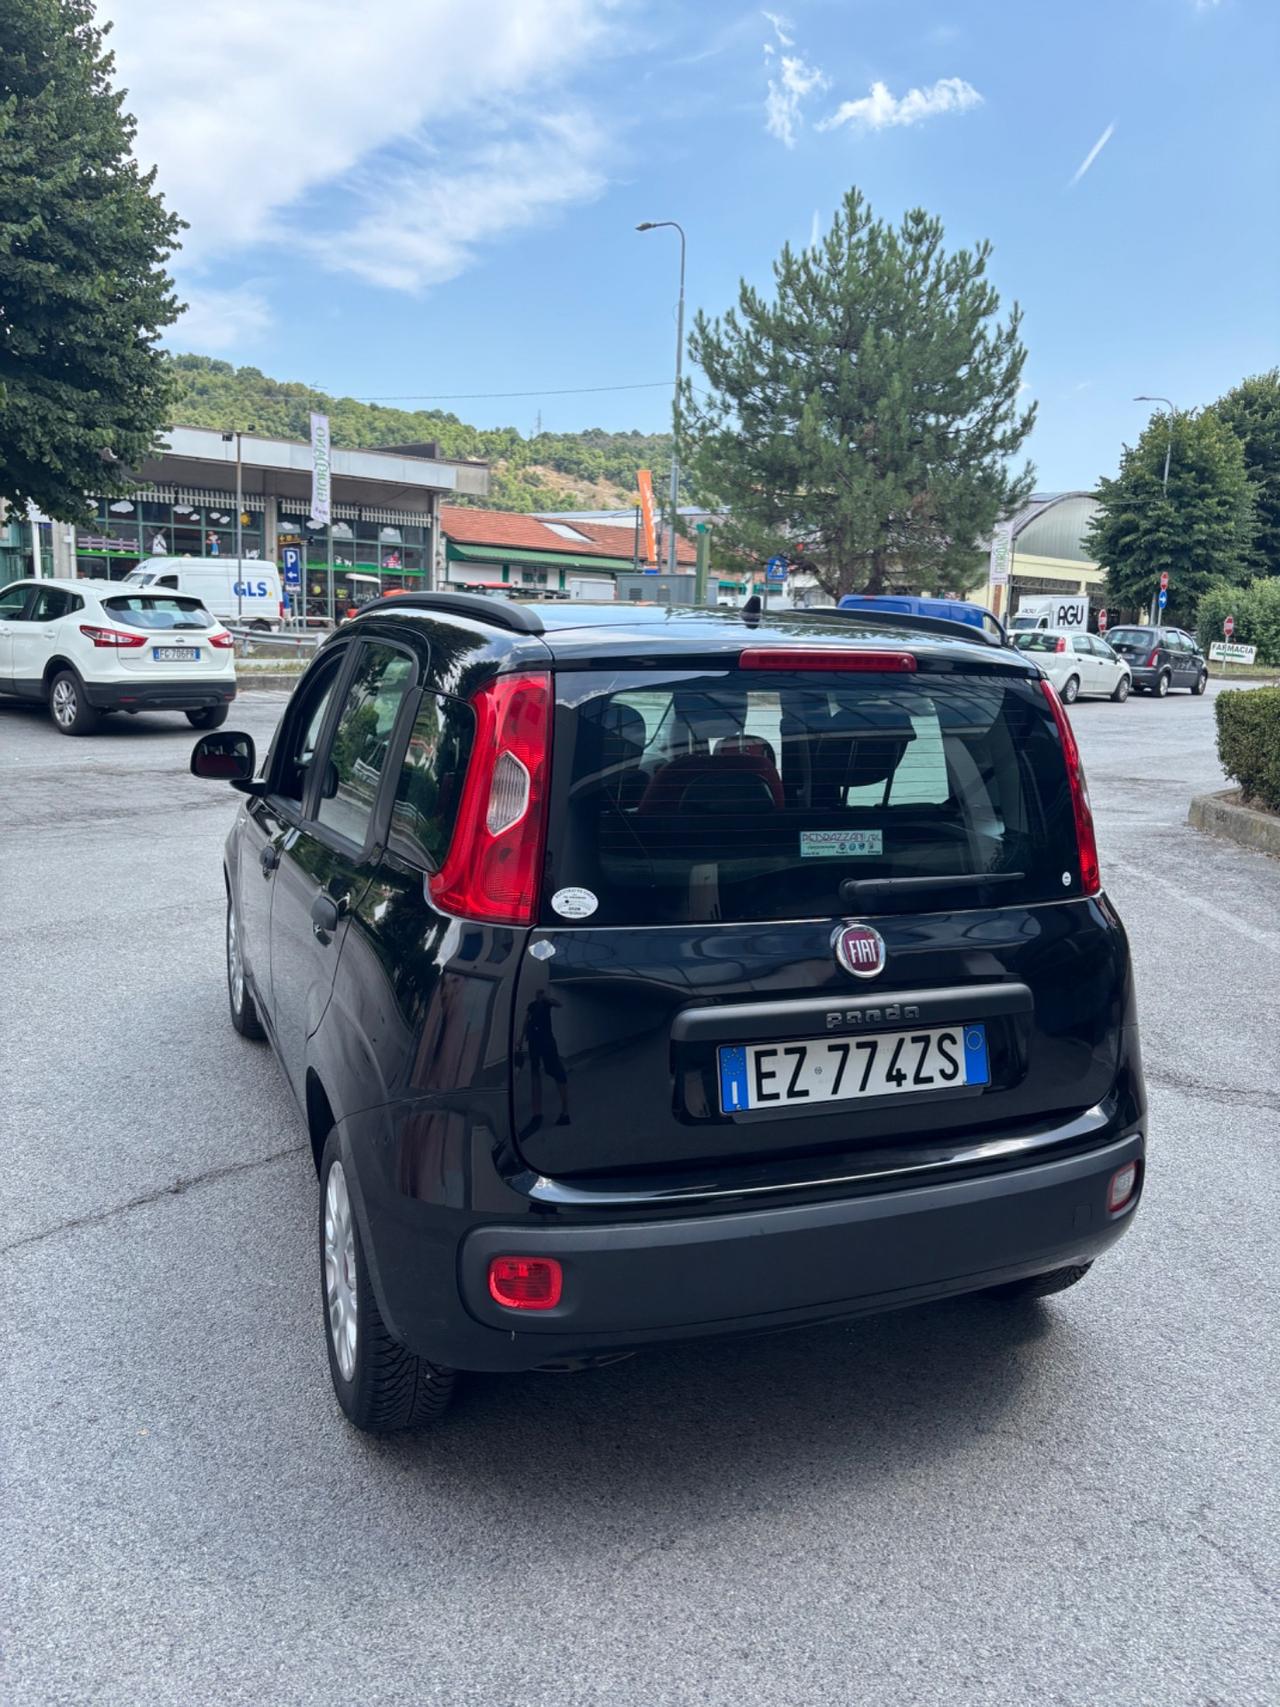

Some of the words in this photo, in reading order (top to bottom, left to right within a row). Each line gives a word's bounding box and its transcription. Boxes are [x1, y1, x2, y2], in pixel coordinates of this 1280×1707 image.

[286, 551, 297, 568] P
[1057, 605, 1084, 626] AGU
[1212, 643, 1254, 655] FARMACIA
[848, 939, 877, 963] FIAT
[754, 1046, 810, 1102] EZ
[827, 1032, 959, 1095] 774ZS
